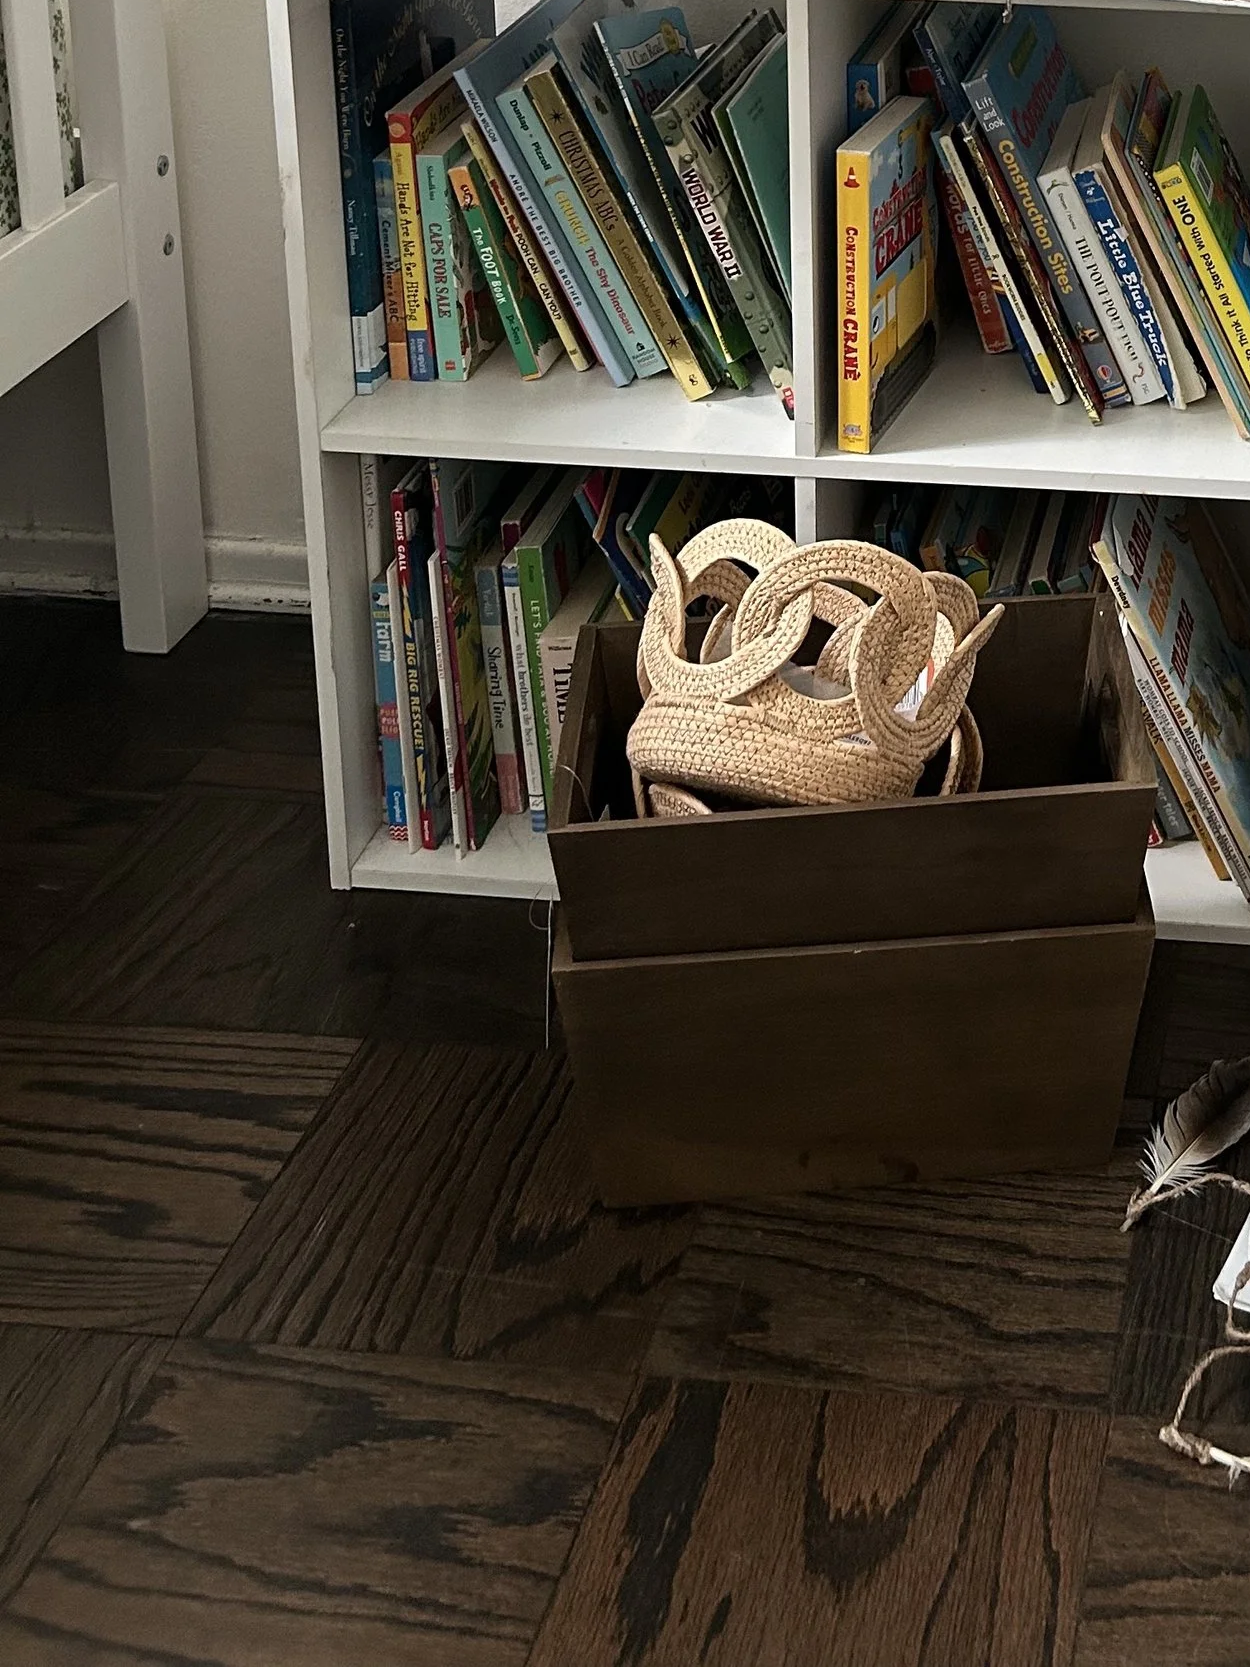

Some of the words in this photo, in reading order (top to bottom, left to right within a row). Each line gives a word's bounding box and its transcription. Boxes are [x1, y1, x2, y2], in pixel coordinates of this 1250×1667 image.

[975, 96, 994, 110] Lift
[510, 99, 529, 132] Dunlap
[532, 141, 552, 171] Pizzoli
[982, 118, 1005, 133] Look
[558, 130, 601, 199] CHRISTMAS
[397, 182, 410, 215] Hands
[681, 168, 717, 225] WORLD
[707, 223, 735, 262] WAR
[998, 139, 1053, 250] Construction
[1048, 252, 1073, 295] Sites
[1172, 194, 1196, 226] ONE
[400, 217, 413, 238] Are
[428, 223, 444, 255] CAPS
[1190, 226, 1207, 252] with
[402, 239, 415, 260] Not
[479, 247, 499, 277] FOOT
[535, 223, 551, 247] BEST
[558, 265, 583, 308] BROTHER
[381, 220, 393, 258] Cement
[388, 298, 400, 323] ABC
[404, 262, 417, 279] for
[432, 258, 448, 284] FOR
[516, 233, 530, 255] POOH
[539, 283, 553, 302] CAN
[548, 300, 563, 321] YOU?
[845, 226, 859, 316] CONSTRUCTION
[1075, 234, 1095, 259] THE
[1087, 258, 1127, 332] POUT-POUT
[1200, 253, 1225, 290] Started
[405, 281, 422, 321] Hitting
[435, 287, 452, 318] SALE
[584, 245, 598, 268] The
[595, 268, 610, 291] Shy
[607, 289, 636, 335] Dinosaur
[1097, 218, 1128, 269] Little
[1122, 272, 1146, 309] Blue
[1138, 307, 1168, 366] Truck
[842, 317, 862, 381] CRANE
[1231, 317, 1250, 345] Think
[363, 463, 377, 501] Messy
[394, 510, 405, 541] CHRIS
[397, 545, 407, 572] GALL
[1111, 575, 1132, 610] Dewdney
[405, 642, 417, 667] BIG
[1171, 597, 1195, 688] mama
[407, 667, 420, 694] RIG
[486, 646, 502, 698] Sharing
[518, 670, 530, 714] brothers
[410, 696, 426, 751] RESCUE!
[493, 695, 507, 730] Time
[1143, 678, 1161, 708] WOMBAT
[1172, 734, 1190, 765] SCHOOL
[1149, 656, 1171, 693] LLAMA
[1165, 690, 1188, 728] LLAMA
[1183, 726, 1206, 763] MISSES
[1200, 760, 1222, 794] MAMA
